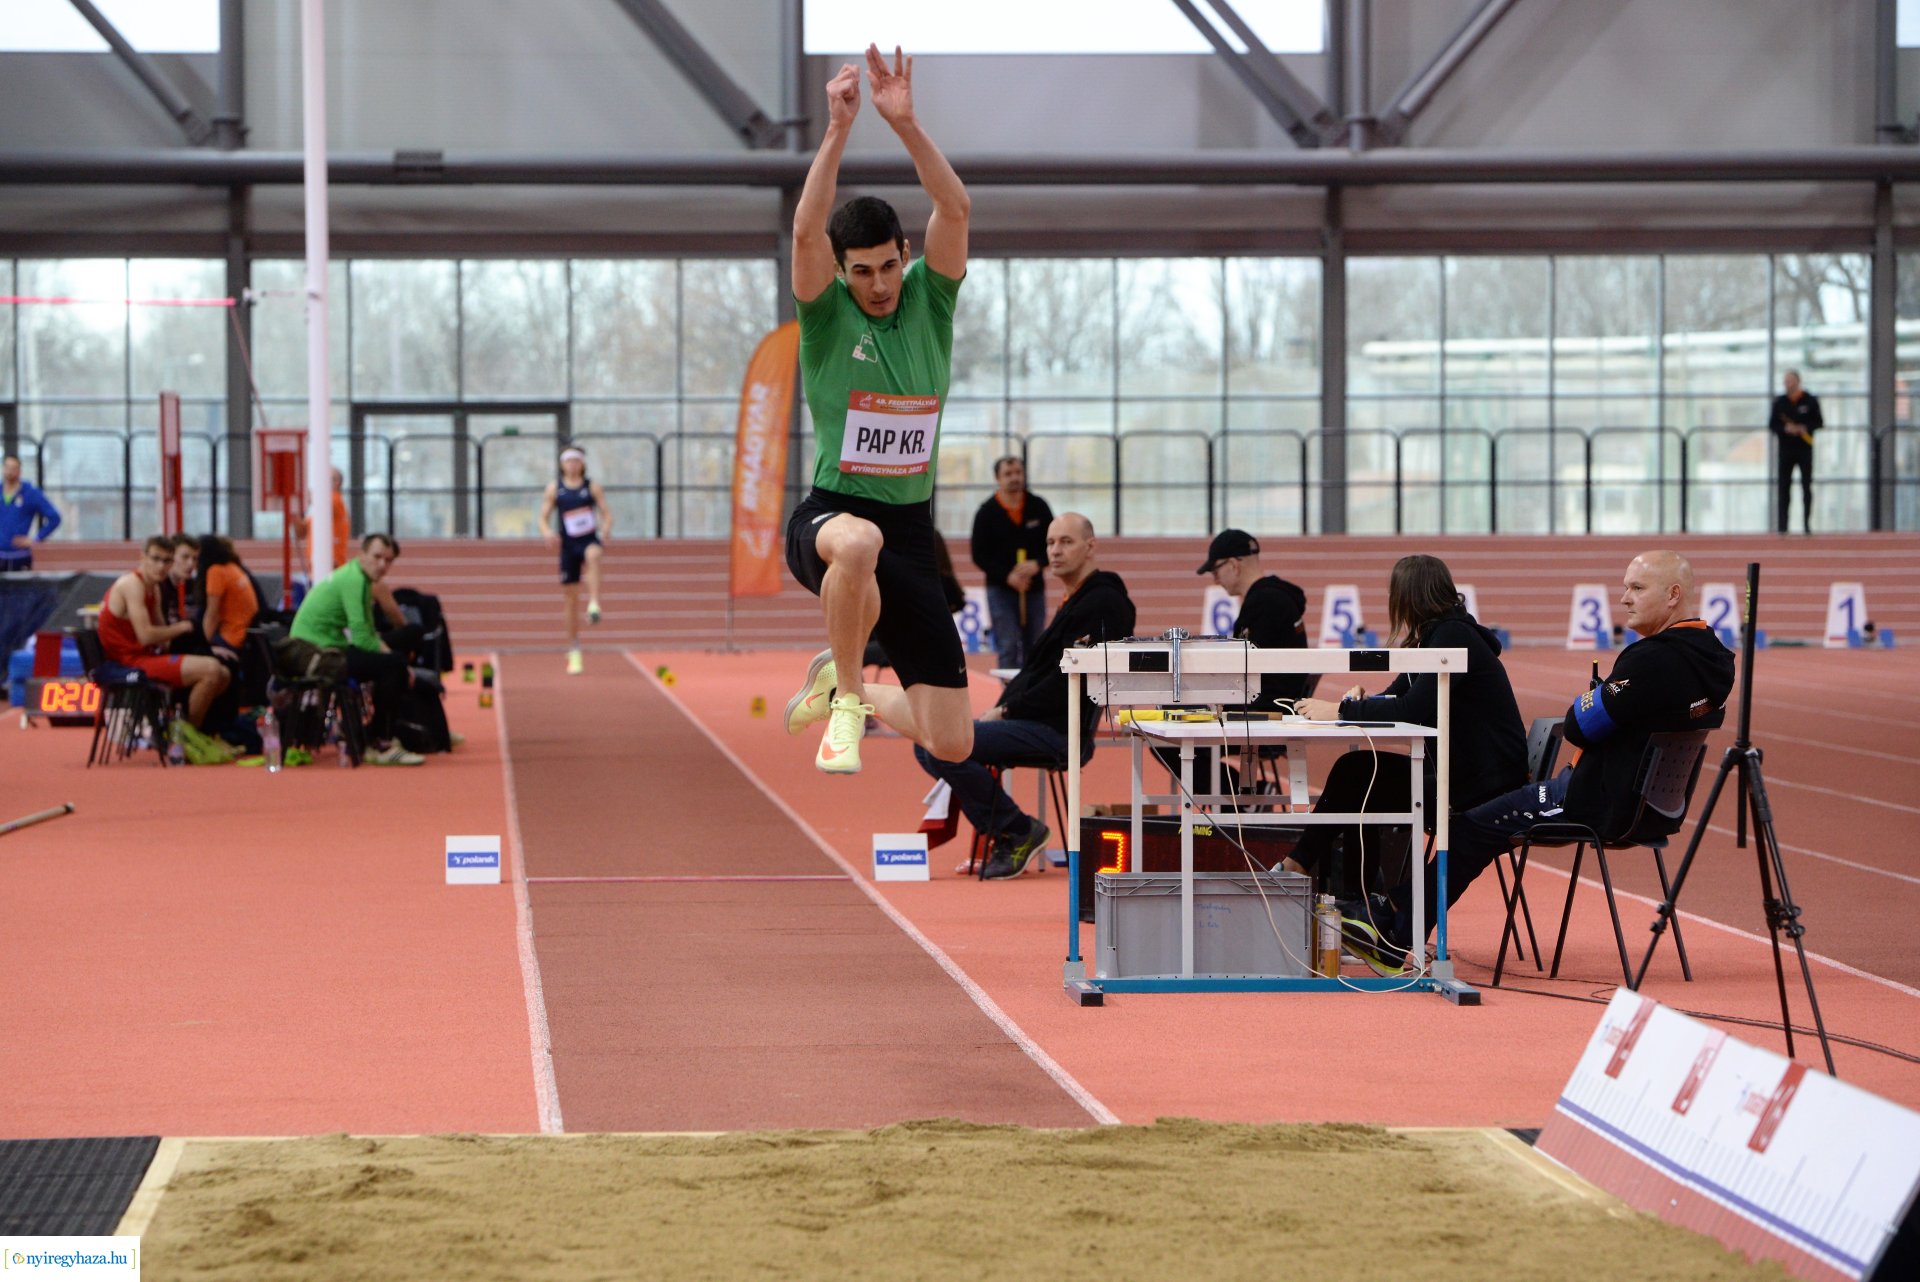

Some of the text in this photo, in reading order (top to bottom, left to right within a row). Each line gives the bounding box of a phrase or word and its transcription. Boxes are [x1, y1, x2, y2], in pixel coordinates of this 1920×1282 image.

[856, 426, 925, 454] PAP KR.
[850, 464, 908, 475] NYÍREGYHÁZA
[1212, 600, 1236, 636] 6
[1332, 597, 1354, 632] 5
[1579, 598, 1601, 632] 3
[1708, 596, 1731, 631] 2
[1839, 597, 1855, 630] 1
[41, 682, 100, 711] 0:20
